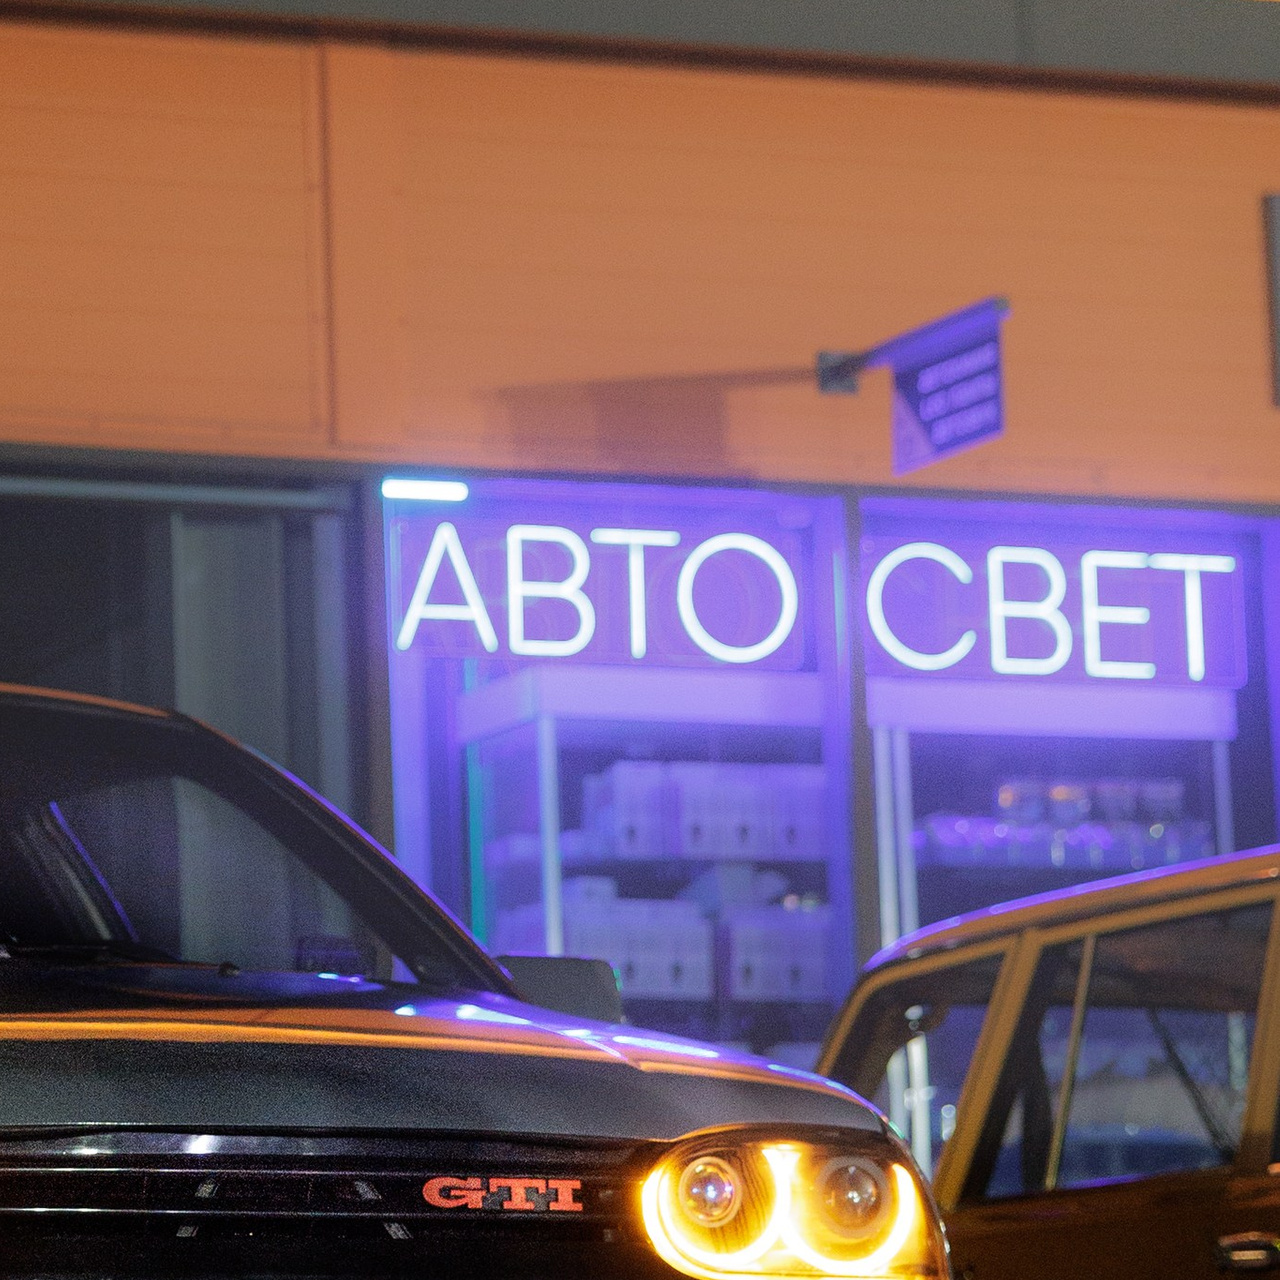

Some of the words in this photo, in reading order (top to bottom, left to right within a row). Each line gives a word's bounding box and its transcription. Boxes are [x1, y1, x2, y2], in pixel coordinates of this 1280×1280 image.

[396, 521, 799, 664] АВТО
[865, 541, 1236, 682] СВЕТ
[422, 1177, 583, 1212] GTI
